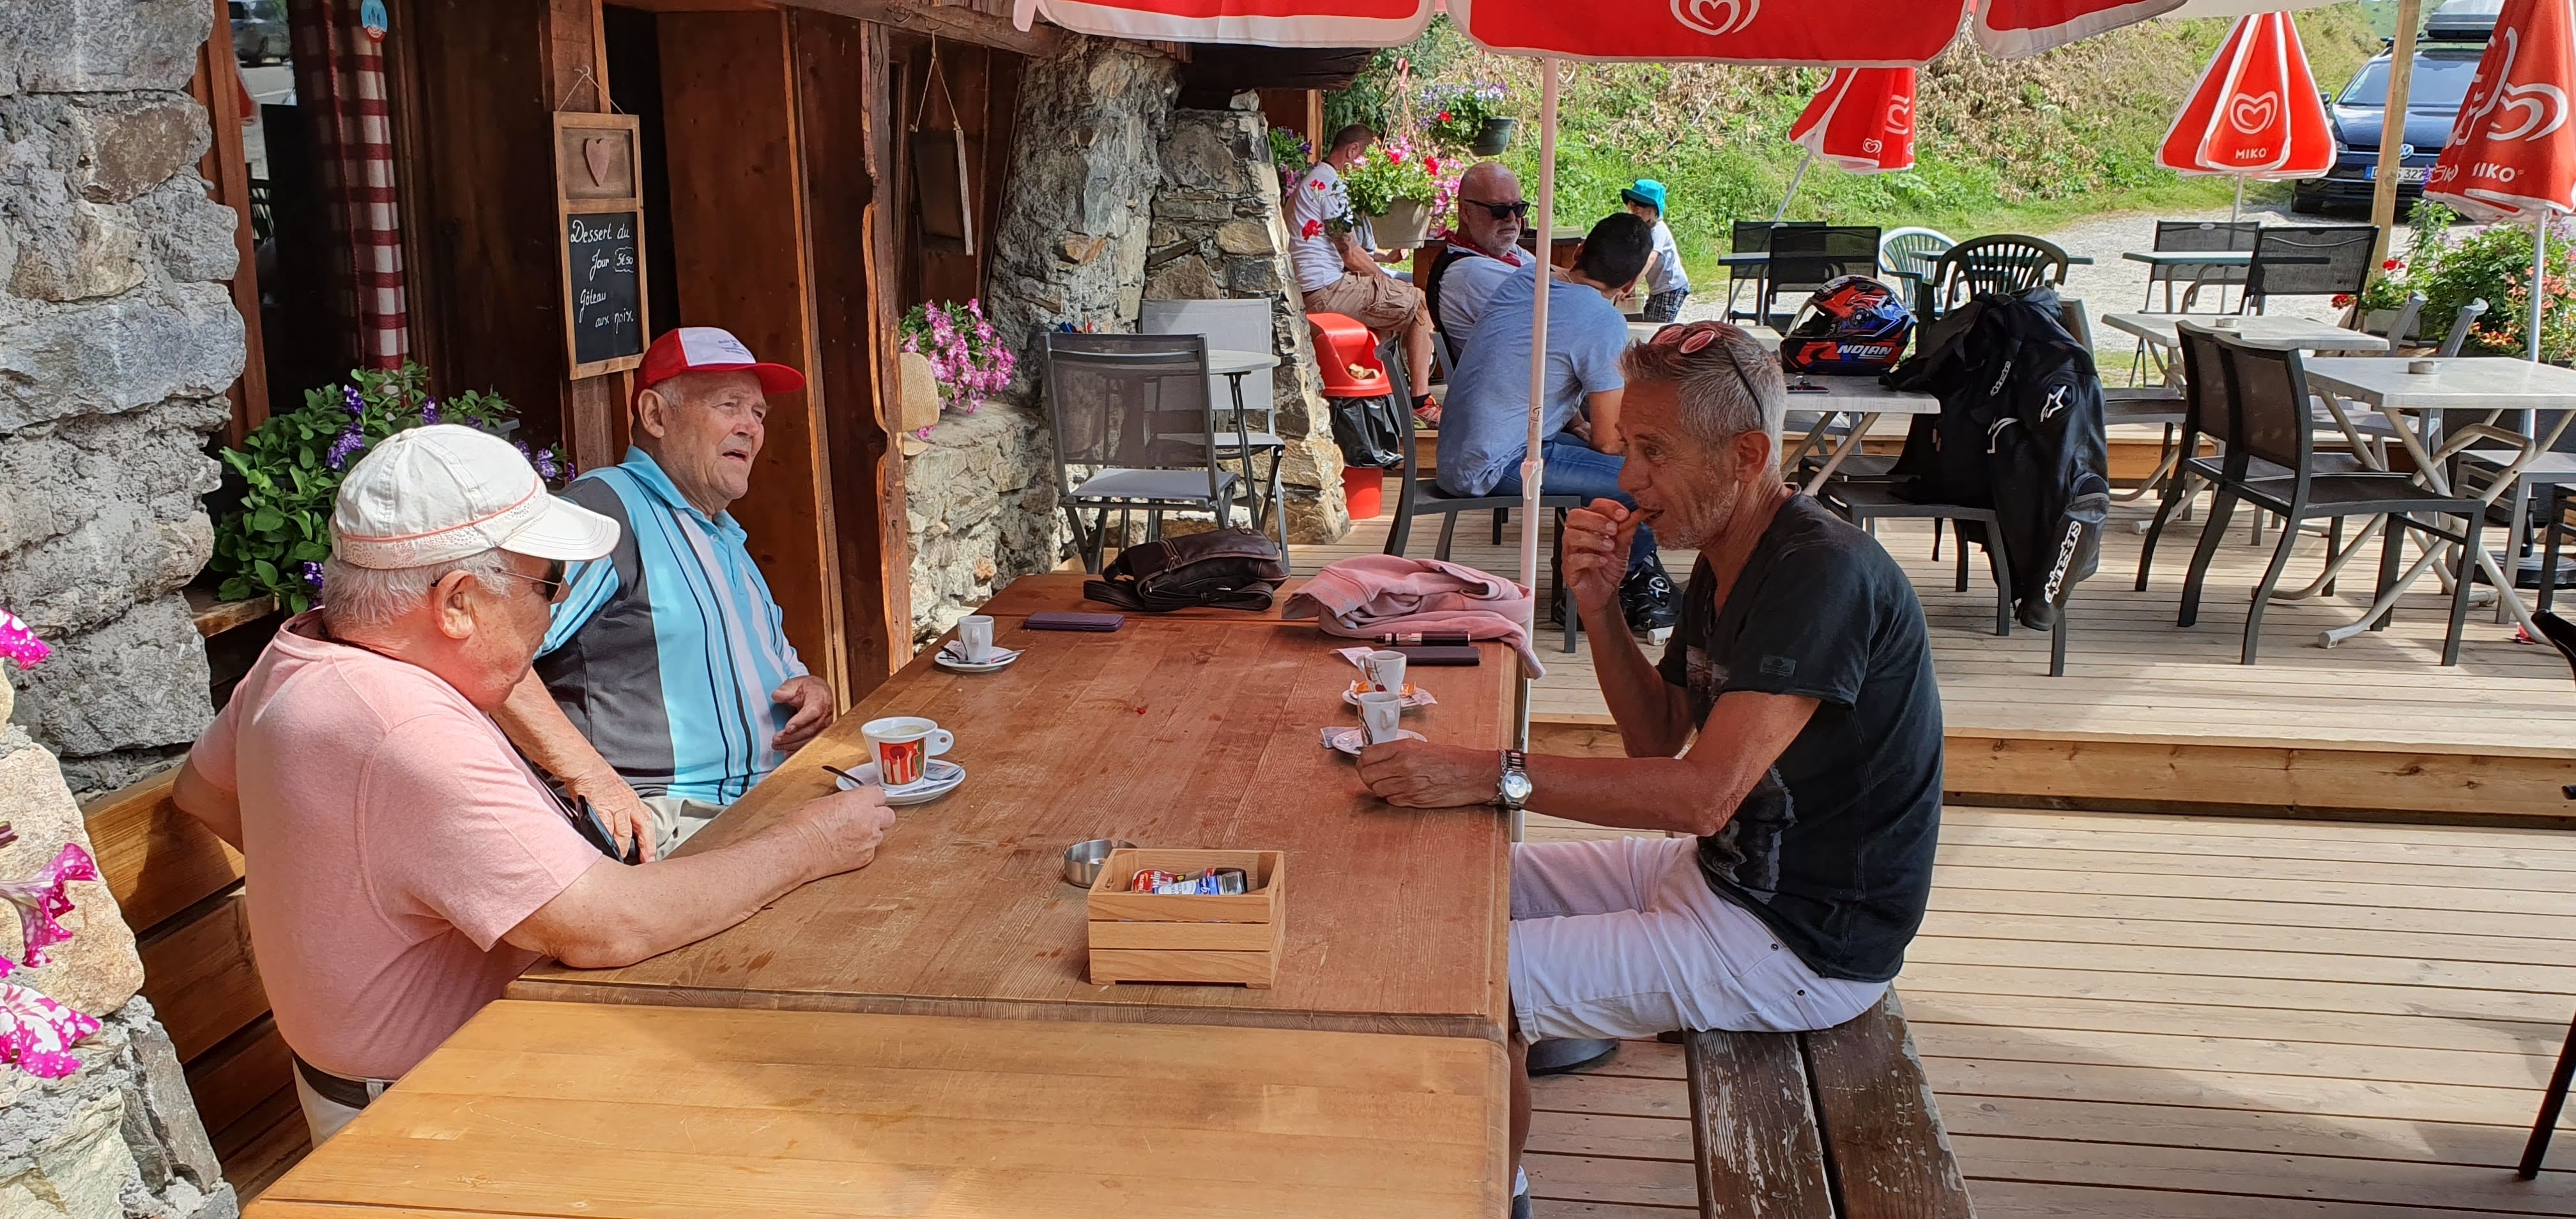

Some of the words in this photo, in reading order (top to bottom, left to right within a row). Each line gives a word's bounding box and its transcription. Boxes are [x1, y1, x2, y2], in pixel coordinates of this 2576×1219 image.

[2235, 148, 2267, 159] MIKO
[571, 219, 613, 243] Dessert
[617, 223, 631, 240] du
[589, 249, 610, 282] Jour
[595, 314, 610, 328] aux
[614, 307, 634, 334] noix
[1837, 344, 1893, 357] NOLAN
